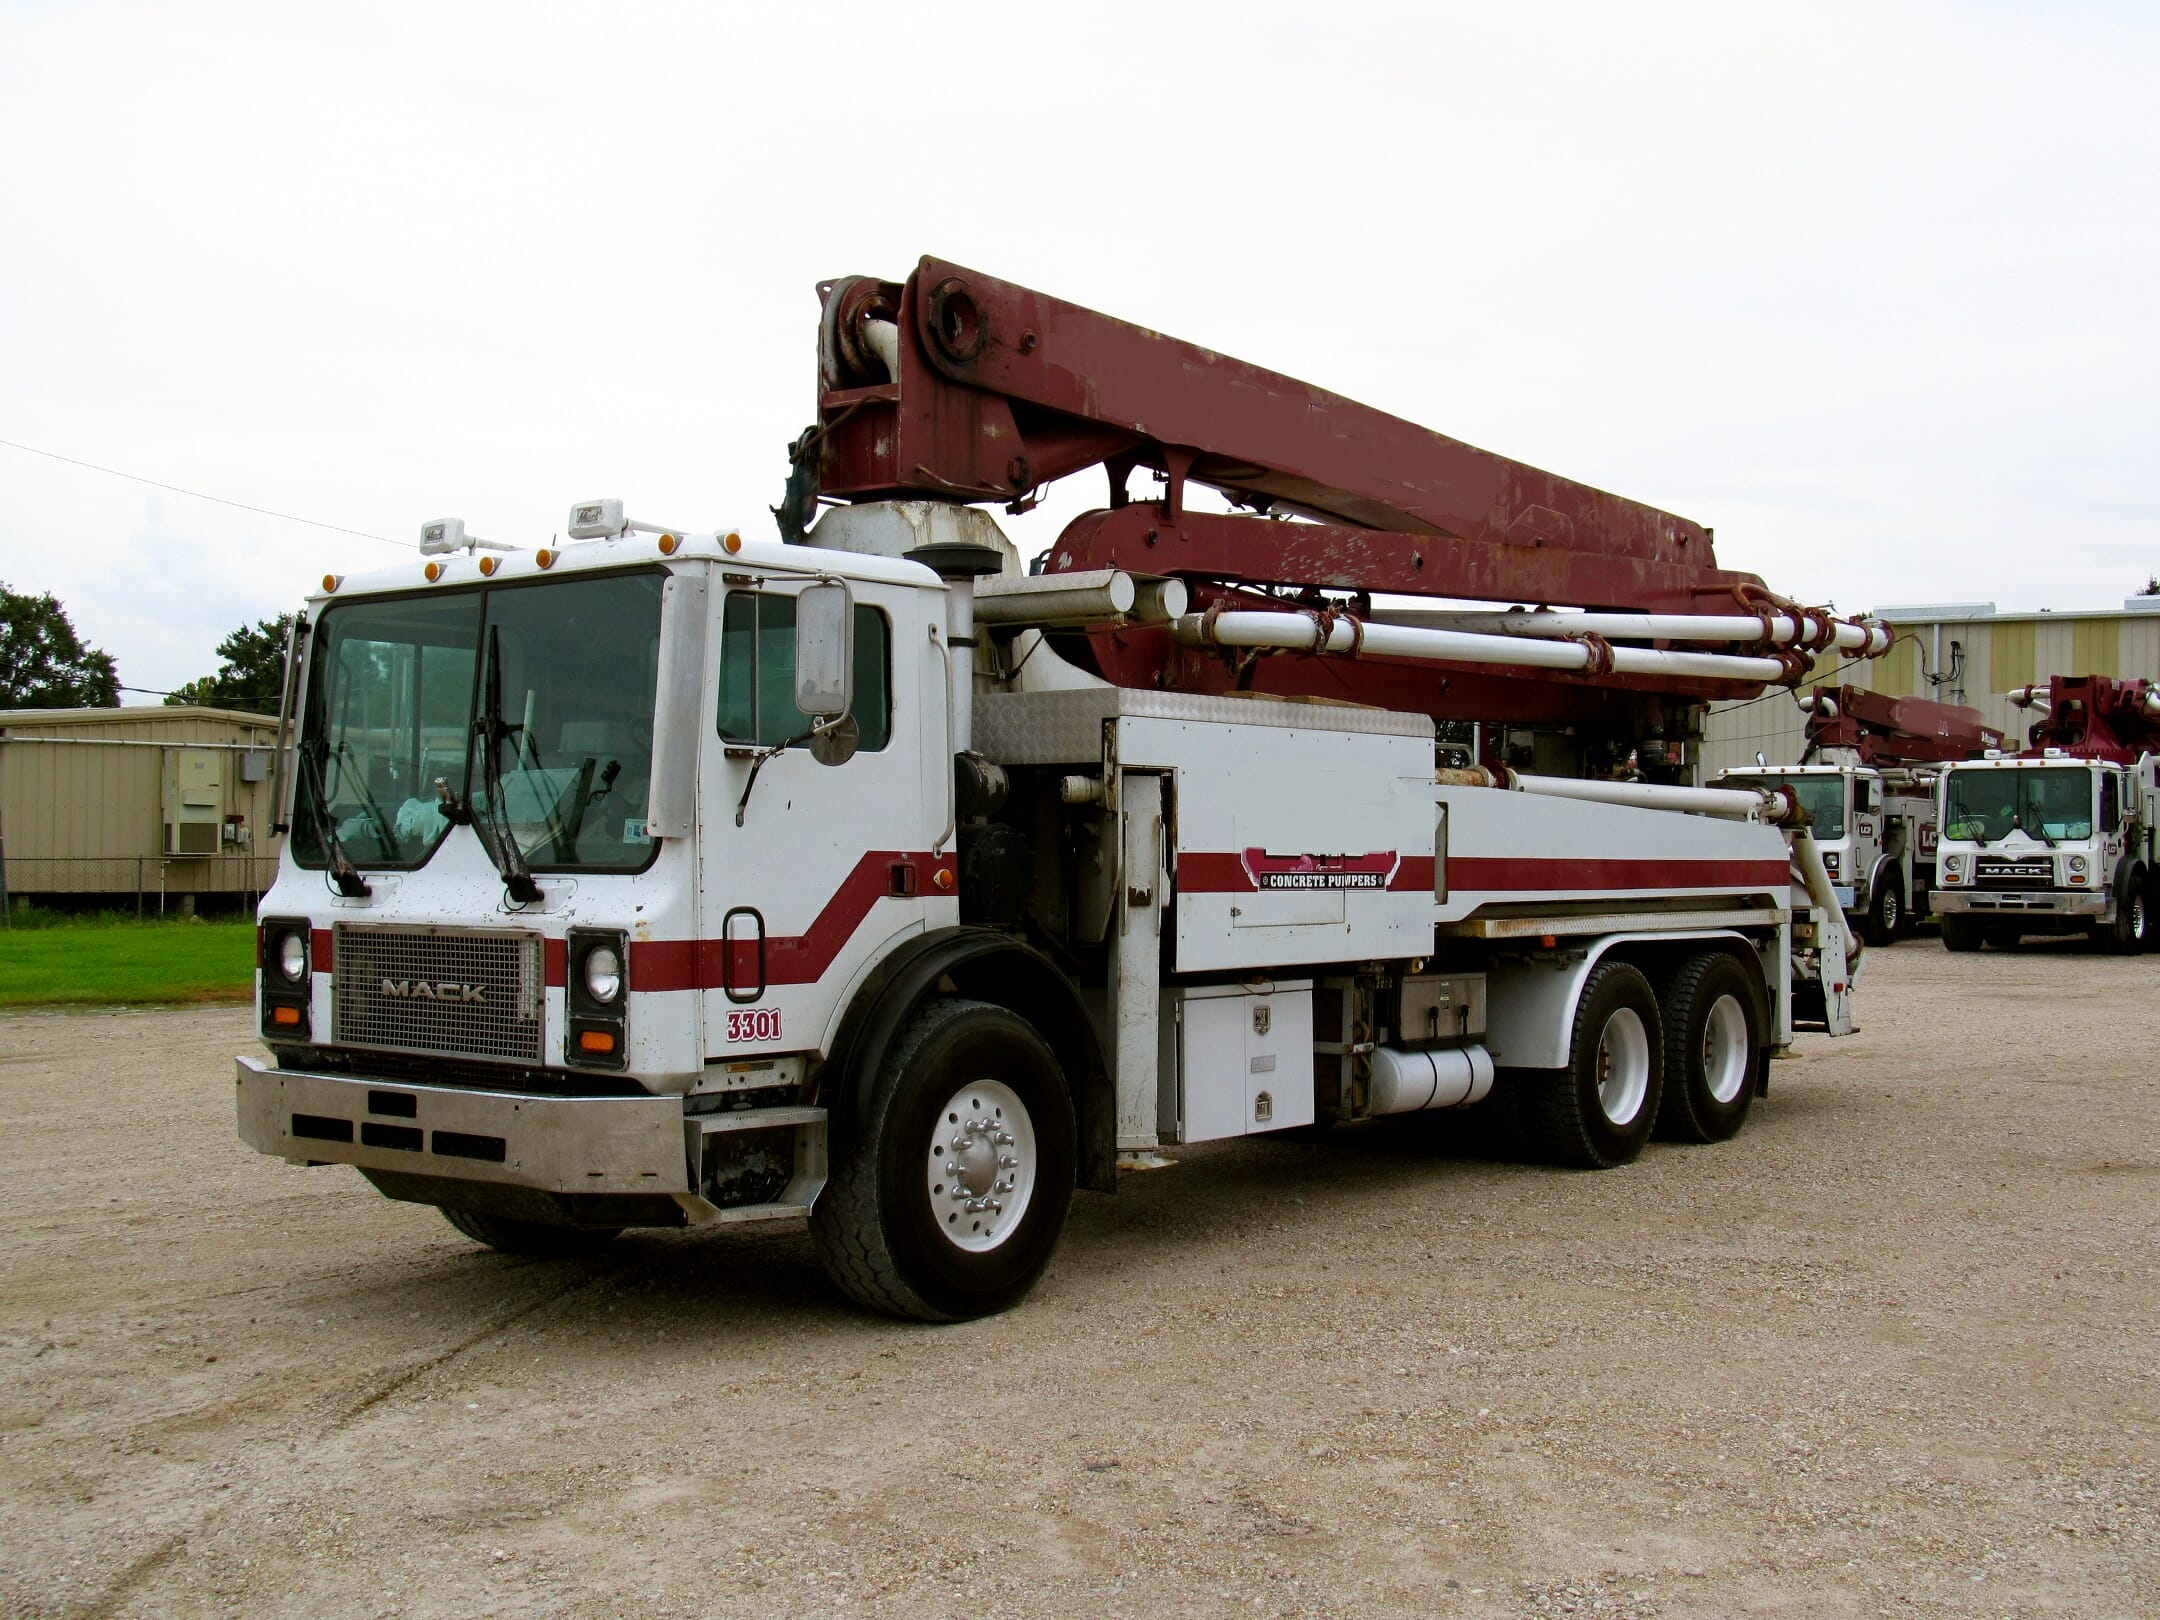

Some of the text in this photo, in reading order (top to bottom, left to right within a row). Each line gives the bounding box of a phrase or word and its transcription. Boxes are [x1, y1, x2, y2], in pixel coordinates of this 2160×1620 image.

[1922, 830, 1937, 847] LC
[1985, 867, 2042, 875] MACK
[1270, 874, 1377, 888] CONCRETE PUMPERS
[382, 978, 488, 1003] MACK
[727, 1009, 782, 1042] 3301
